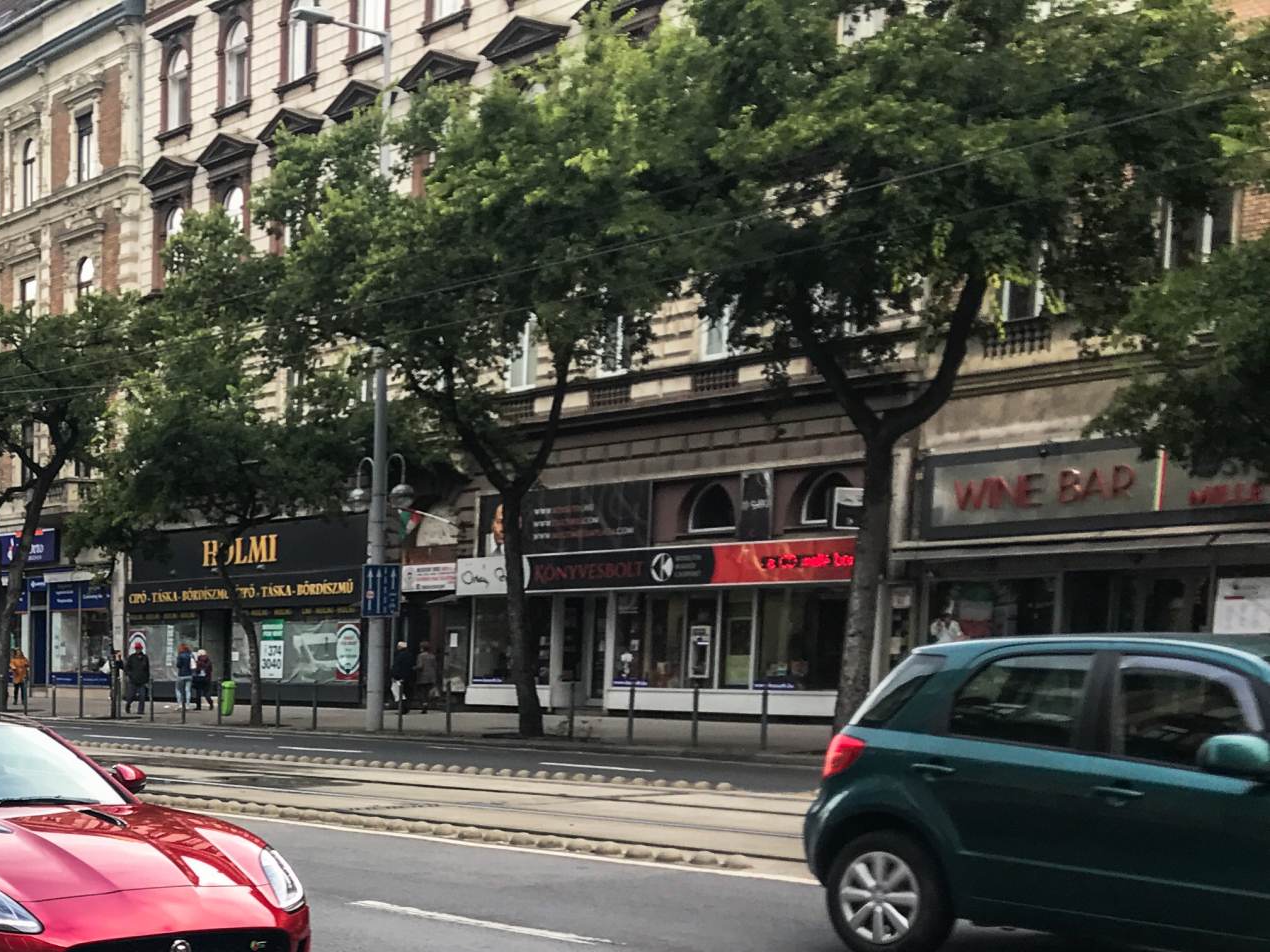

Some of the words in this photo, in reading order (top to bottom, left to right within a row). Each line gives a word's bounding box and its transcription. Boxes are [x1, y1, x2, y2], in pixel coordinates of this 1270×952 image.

[953, 472, 1044, 511] WINE
[1058, 464, 1136, 504] BAR
[534, 561, 645, 584] KÖNYVESBOLT
[128, 590, 147, 604] CIPŐ
[151, 589, 178, 603] TÁSKA
[261, 582, 292, 598] TÁSKA
[296, 578, 354, 596] BŐRDÍSZMŰ
